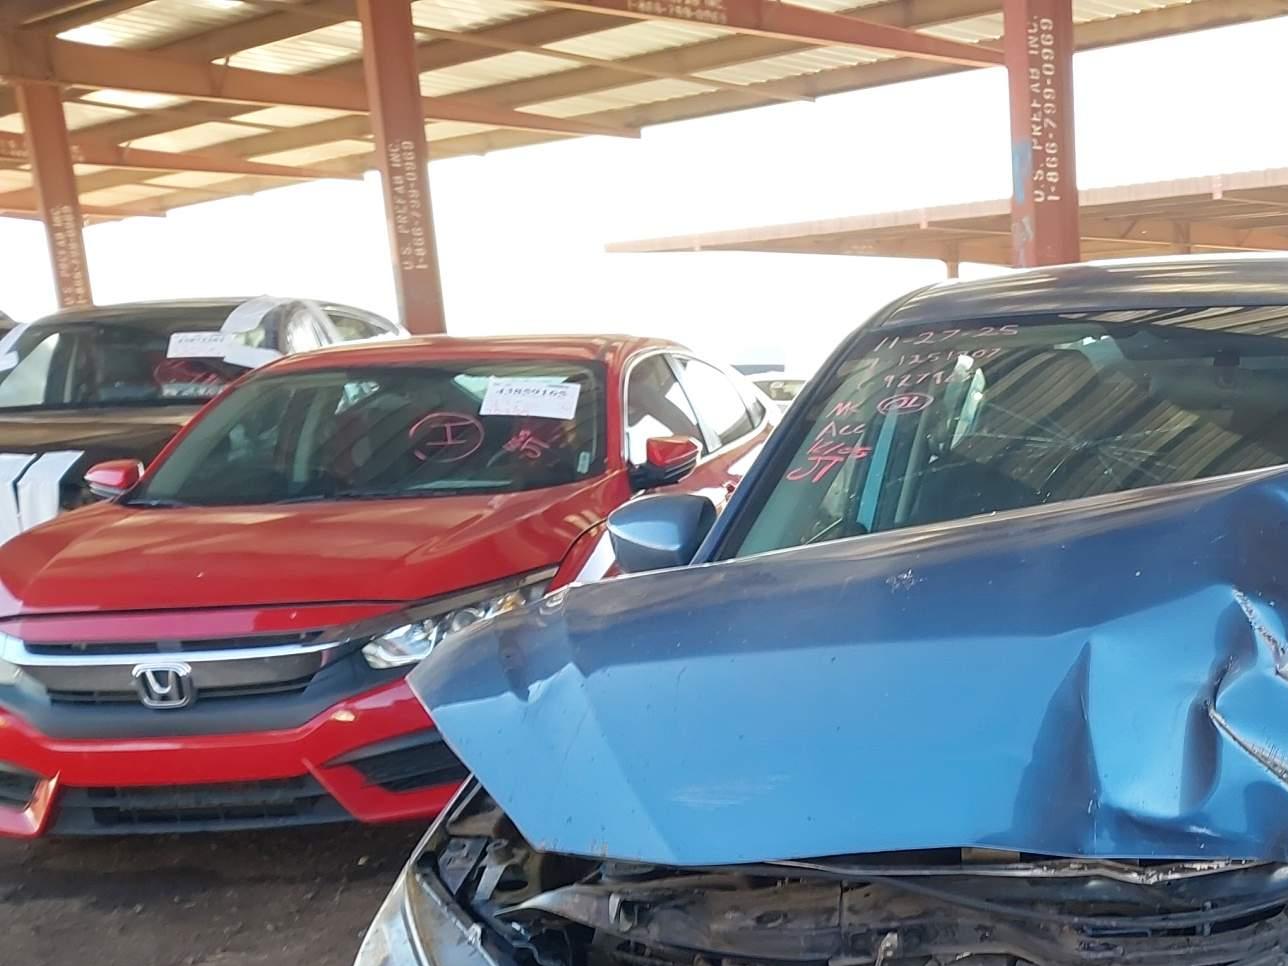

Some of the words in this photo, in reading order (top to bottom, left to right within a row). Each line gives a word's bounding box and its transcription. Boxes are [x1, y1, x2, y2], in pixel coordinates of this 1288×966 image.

[1039, 17, 1061, 201] 1-866-799-0969
[1032, 162, 1046, 202] U.S.
[873, 324, 1020, 352] 11-27-25
